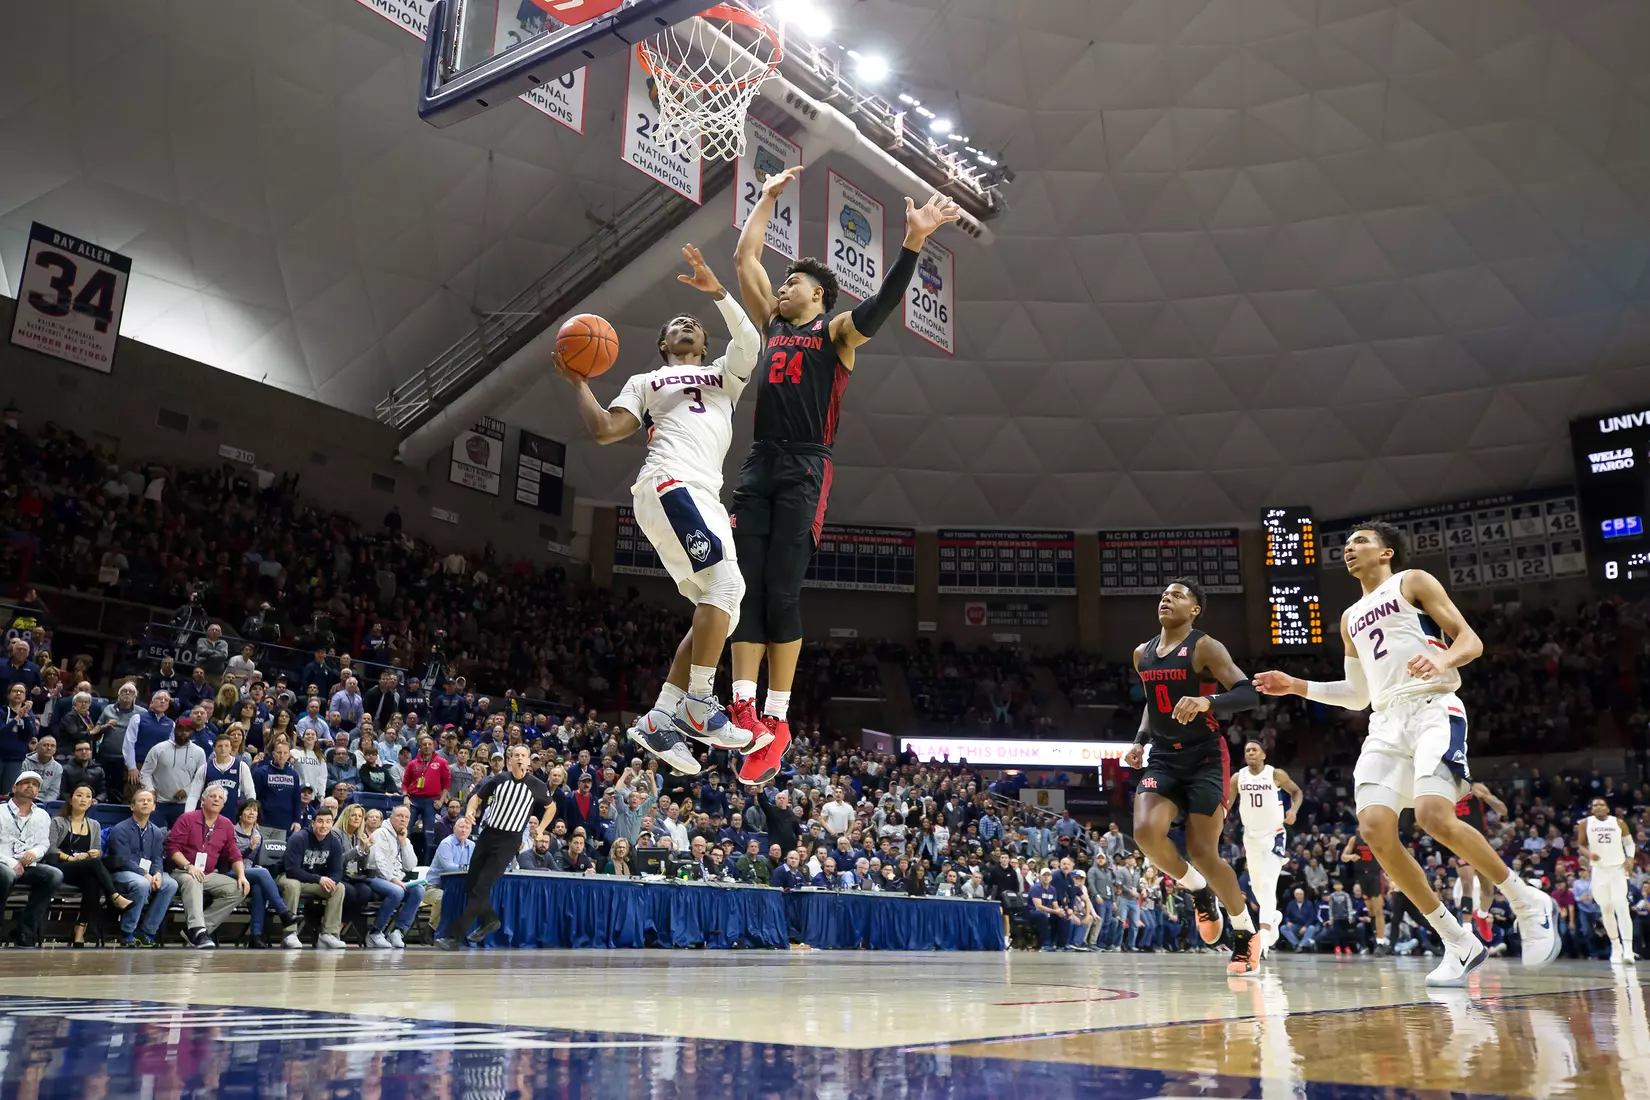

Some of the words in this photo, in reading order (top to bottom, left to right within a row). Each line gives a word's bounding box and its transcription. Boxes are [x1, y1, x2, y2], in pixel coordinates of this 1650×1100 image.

[754, 131, 787, 157] Basketball
[638, 141, 689, 178] NATIONAL
[632, 153, 692, 194] CHAMPIONS
[834, 176, 854, 192] UConn
[855, 187, 879, 210] Women's
[843, 191, 872, 214] Basketball
[53, 233, 75, 250] RAY
[78, 244, 112, 263] ALLEN
[834, 239, 876, 278] 2015
[836, 263, 875, 291] NATIONAL
[28, 251, 117, 334] 34
[912, 287, 948, 323] 2016
[913, 310, 946, 335] NATIONAL
[767, 335, 823, 350] HOUSTON
[910, 320, 949, 348] CHAMPIONS
[18, 329, 62, 348] NUMBER
[65, 344, 107, 362] RETIRED
[768, 352, 803, 385] 24
[650, 374, 724, 392] UCONN
[683, 387, 707, 414] 3
[236, 450, 253, 462] 210
[1588, 448, 1634, 463] WELLS
[1591, 458, 1635, 473] FARGO
[1551, 515, 1575, 530] 42
[853, 535, 903, 543] CHAMPIONS
[1106, 532, 1137, 540] NCAA
[1143, 530, 1231, 539] CHAMPIONSHIP
[1450, 529, 1472, 543] 42
[1483, 525, 1505, 539] 44
[1417, 533, 1440, 549] 25
[617, 567, 667, 578] CONNECTICU
[1454, 568, 1476, 583] 24
[1489, 564, 1508, 578] 13
[1522, 559, 1544, 575] 22
[1605, 561, 1618, 579] 8
[1349, 598, 1400, 638] UCONN
[150, 646, 169, 656] SEC
[1368, 628, 1388, 661] 2
[1138, 669, 1187, 681] HOUSTON
[1155, 684, 1172, 713] 0
[958, 746, 992, 757] THIS
[998, 747, 1040, 758] DUNK
[269, 775, 293, 783] UCONN
[1249, 793, 1263, 808] 10
[1597, 833, 1612, 843] 25
